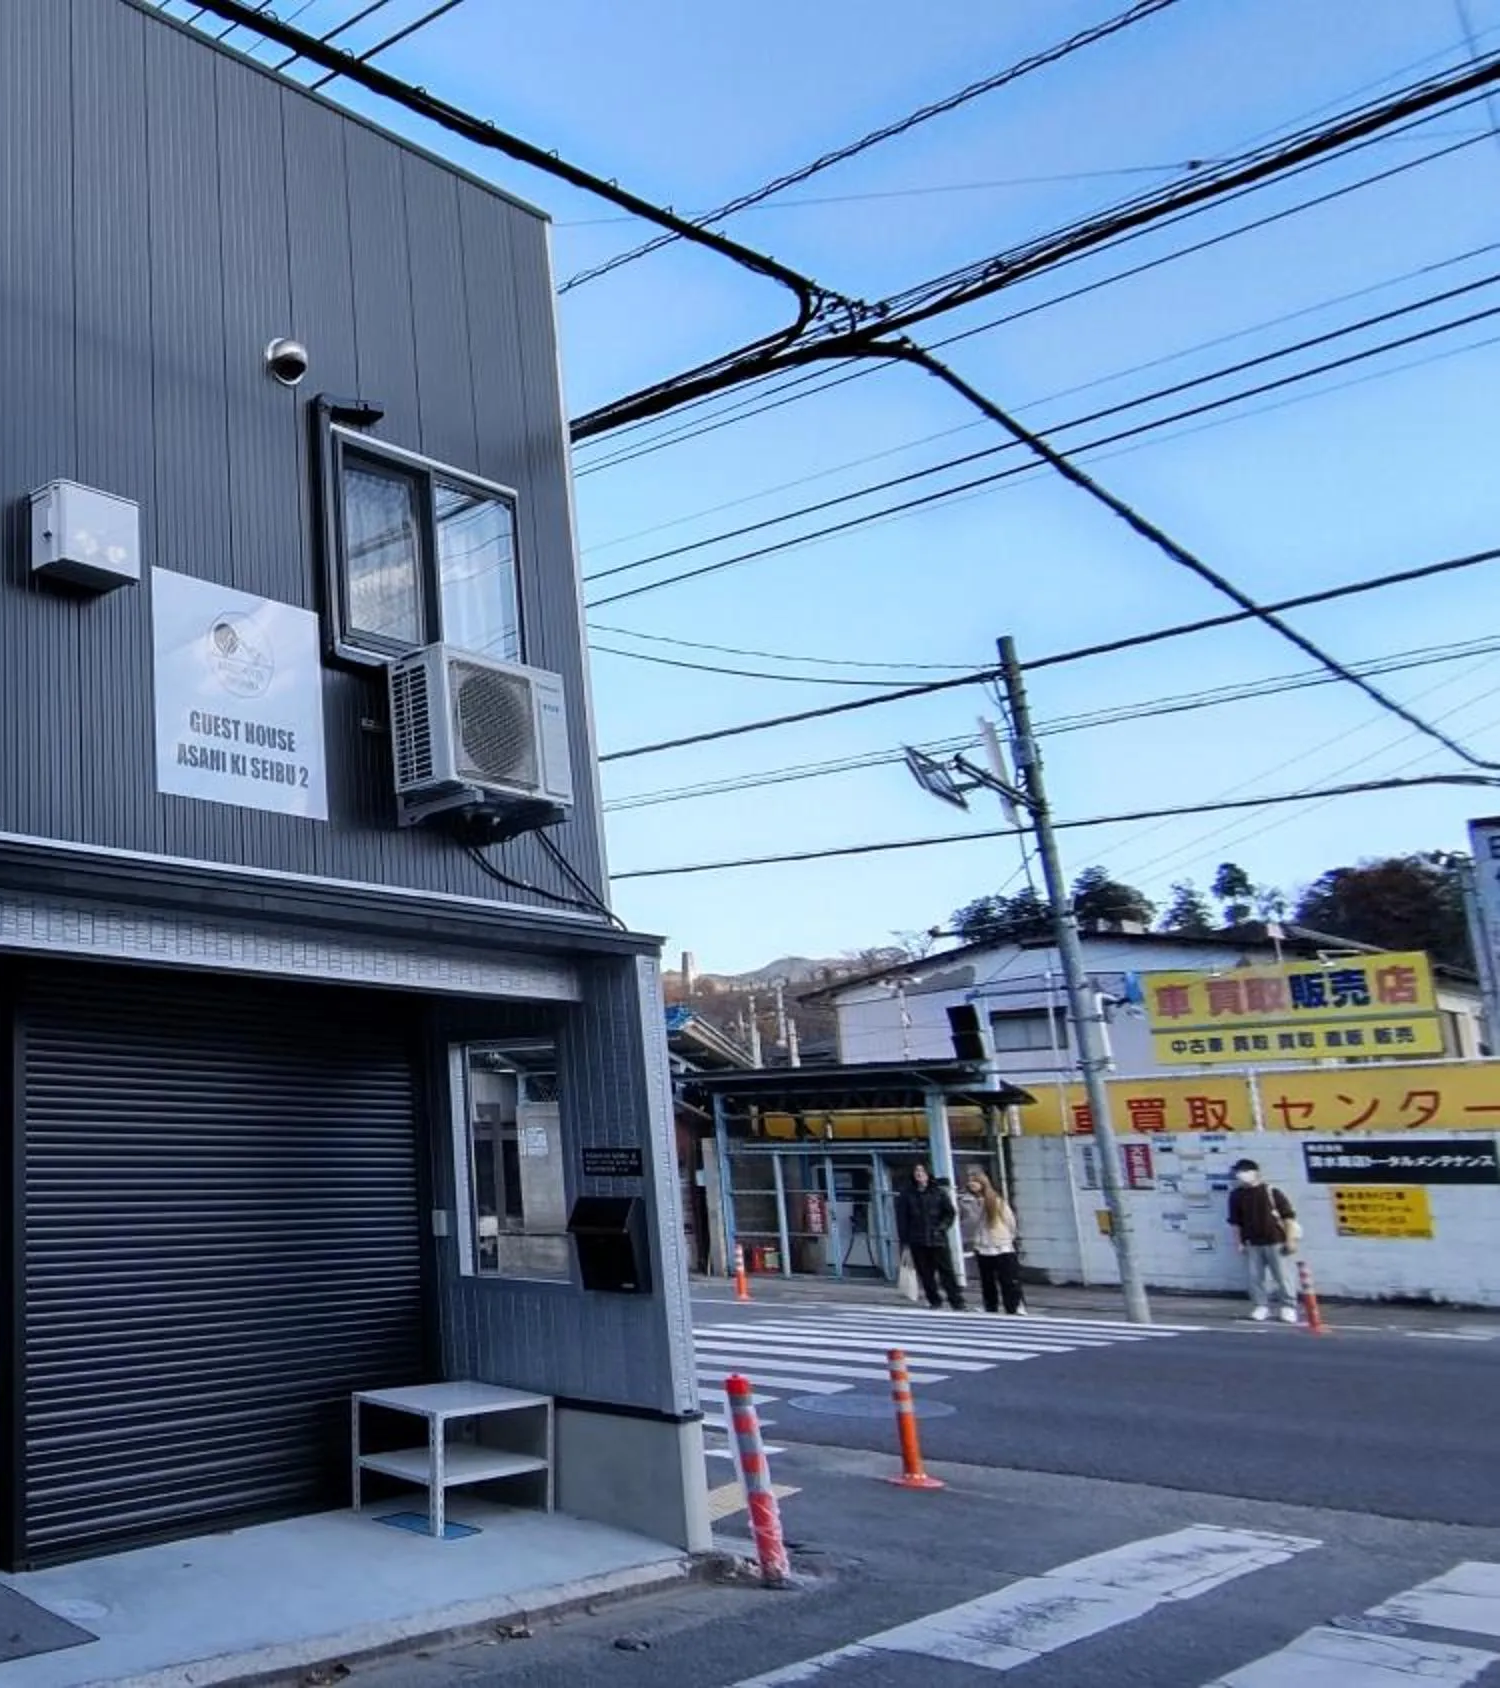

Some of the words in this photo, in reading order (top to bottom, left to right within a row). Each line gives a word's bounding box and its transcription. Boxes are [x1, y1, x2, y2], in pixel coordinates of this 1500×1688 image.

[190, 710, 241, 741] GUEST
[244, 721, 296, 753] HOUSE
[177, 743, 228, 773] ASAHI
[231, 753, 247, 777] KI
[251, 757, 297, 787] SEIBU
[299, 766, 310, 788] 2
